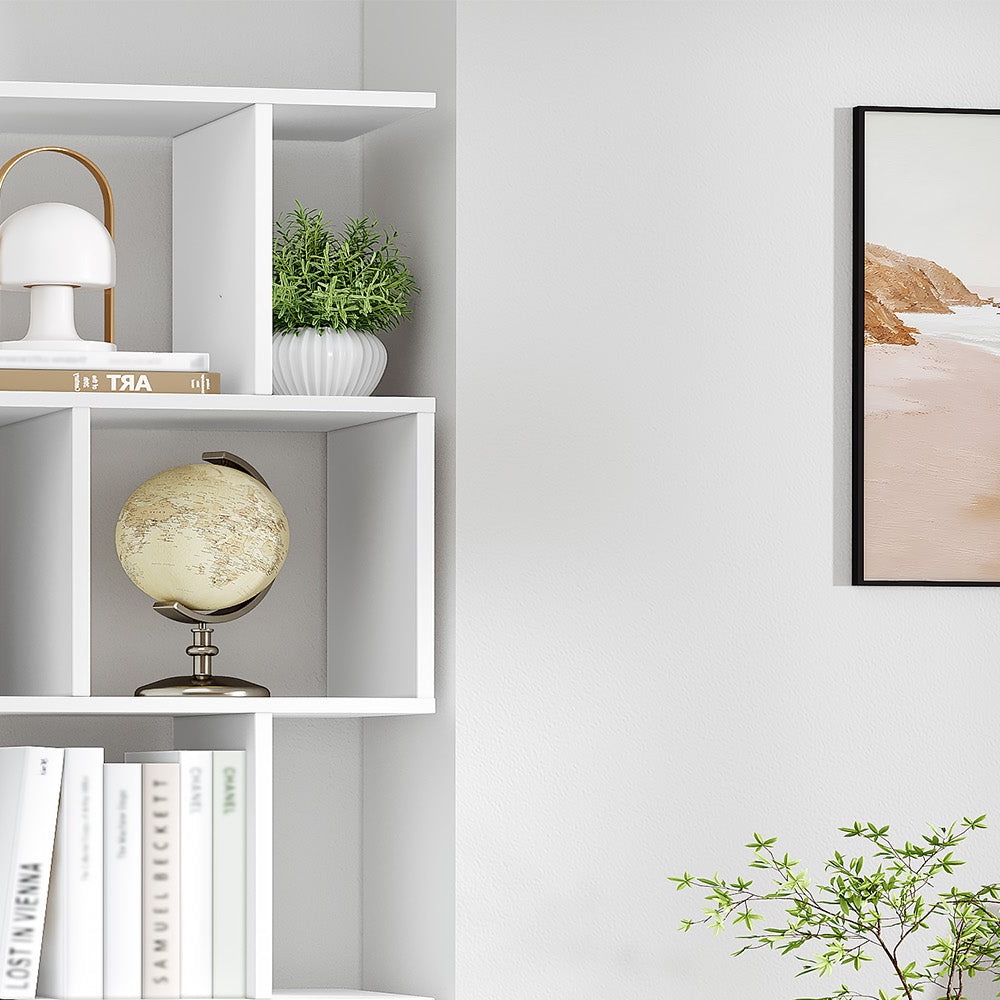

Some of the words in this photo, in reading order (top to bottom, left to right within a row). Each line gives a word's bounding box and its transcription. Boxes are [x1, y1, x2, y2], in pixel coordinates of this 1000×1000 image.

[152, 778, 169, 882] BECKETT
[14, 862, 41, 922] VIENNA
[12, 927, 34, 943] IN
[152, 892, 169, 985] SAMUEL
[5, 947, 31, 989] LOST
